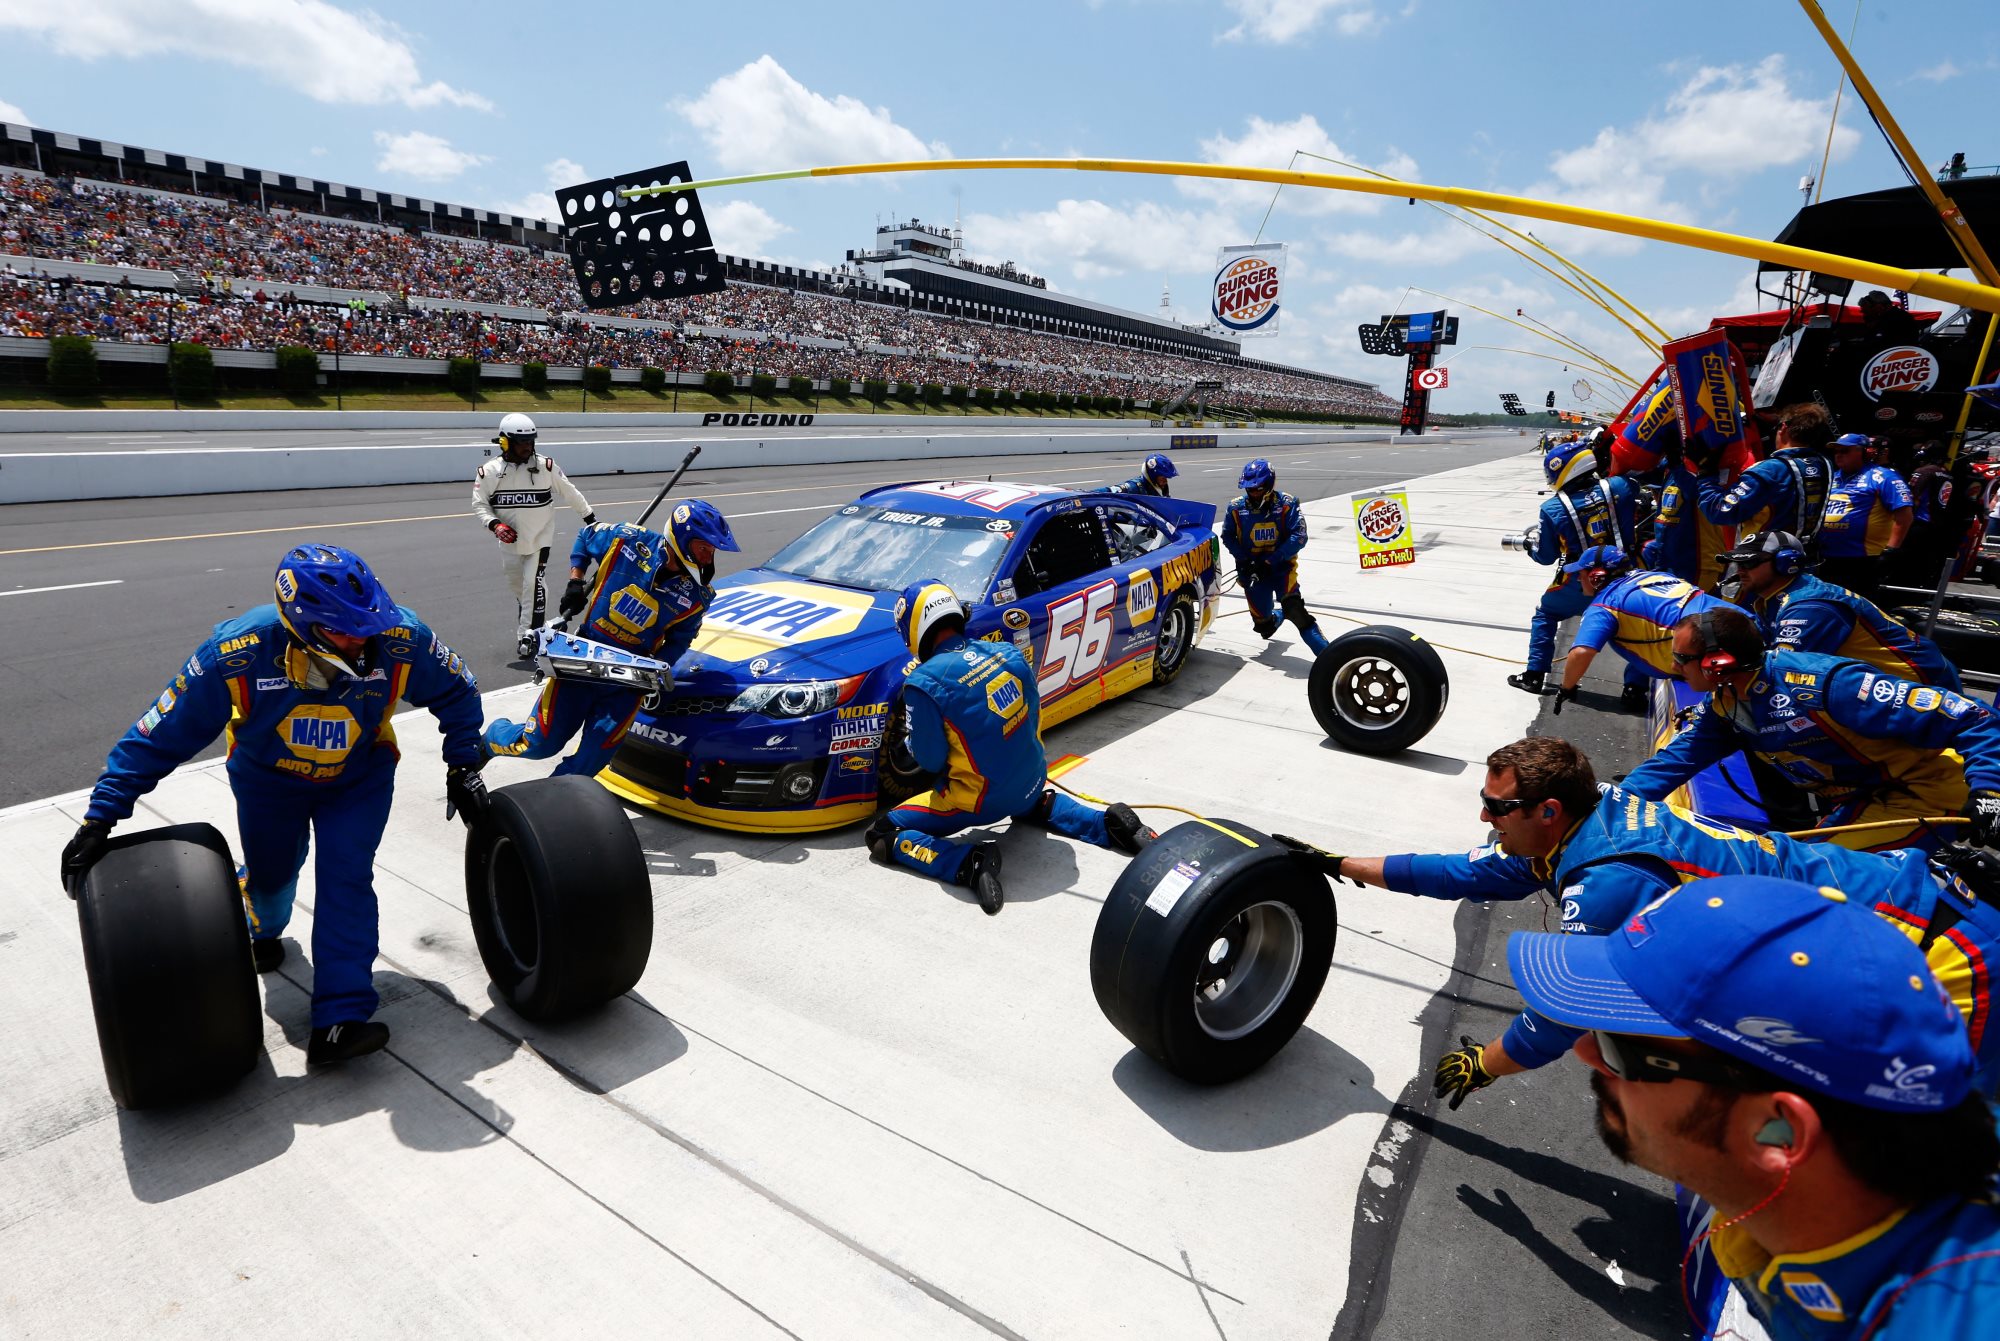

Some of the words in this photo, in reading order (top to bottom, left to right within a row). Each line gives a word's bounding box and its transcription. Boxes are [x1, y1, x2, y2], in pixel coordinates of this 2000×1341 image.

[1218, 267, 1277, 298] BURGER
[1219, 280, 1279, 316] KING
[1870, 357, 1930, 378] BURGER
[1870, 367, 1931, 391] KING
[1706, 357, 1735, 432] SUNOCO
[702, 413, 814, 426] POCONO
[497, 493, 539, 505] OFFICIAL
[877, 511, 924, 525] TRUEX
[922, 516, 949, 528] JR.
[1362, 503, 1399, 526] BURGER
[1365, 510, 1402, 536] KING
[1254, 528, 1275, 541] NAPA
[1362, 554, 1388, 567] DRIVE
[1388, 550, 1413, 563] THRU
[1161, 551, 1192, 596] AUTO
[278, 573, 293, 600] NAPA
[1131, 581, 1155, 614] NAPA
[613, 593, 653, 627] NAPA
[706, 590, 843, 638] NAPA
[220, 633, 261, 655] NAPA
[1037, 580, 1117, 698] 56
[259, 677, 287, 689] PEAK
[1784, 671, 1816, 686] NAPA
[992, 679, 1021, 712] NAPA
[837, 702, 889, 720] MOOG
[292, 717, 347, 750] NAPA
[628, 721, 688, 746] MRY
[832, 718, 886, 737] MAHLE
[831, 737, 871, 752] COMP
[275, 757, 313, 775] AUTO
[841, 759, 873, 770] SUNOCO
[900, 840, 939, 865] AUTO
[1694, 1017, 1741, 1043] michael
[1739, 1037, 1788, 1064] waltrip
[1788, 1283, 1840, 1309] NAPA
